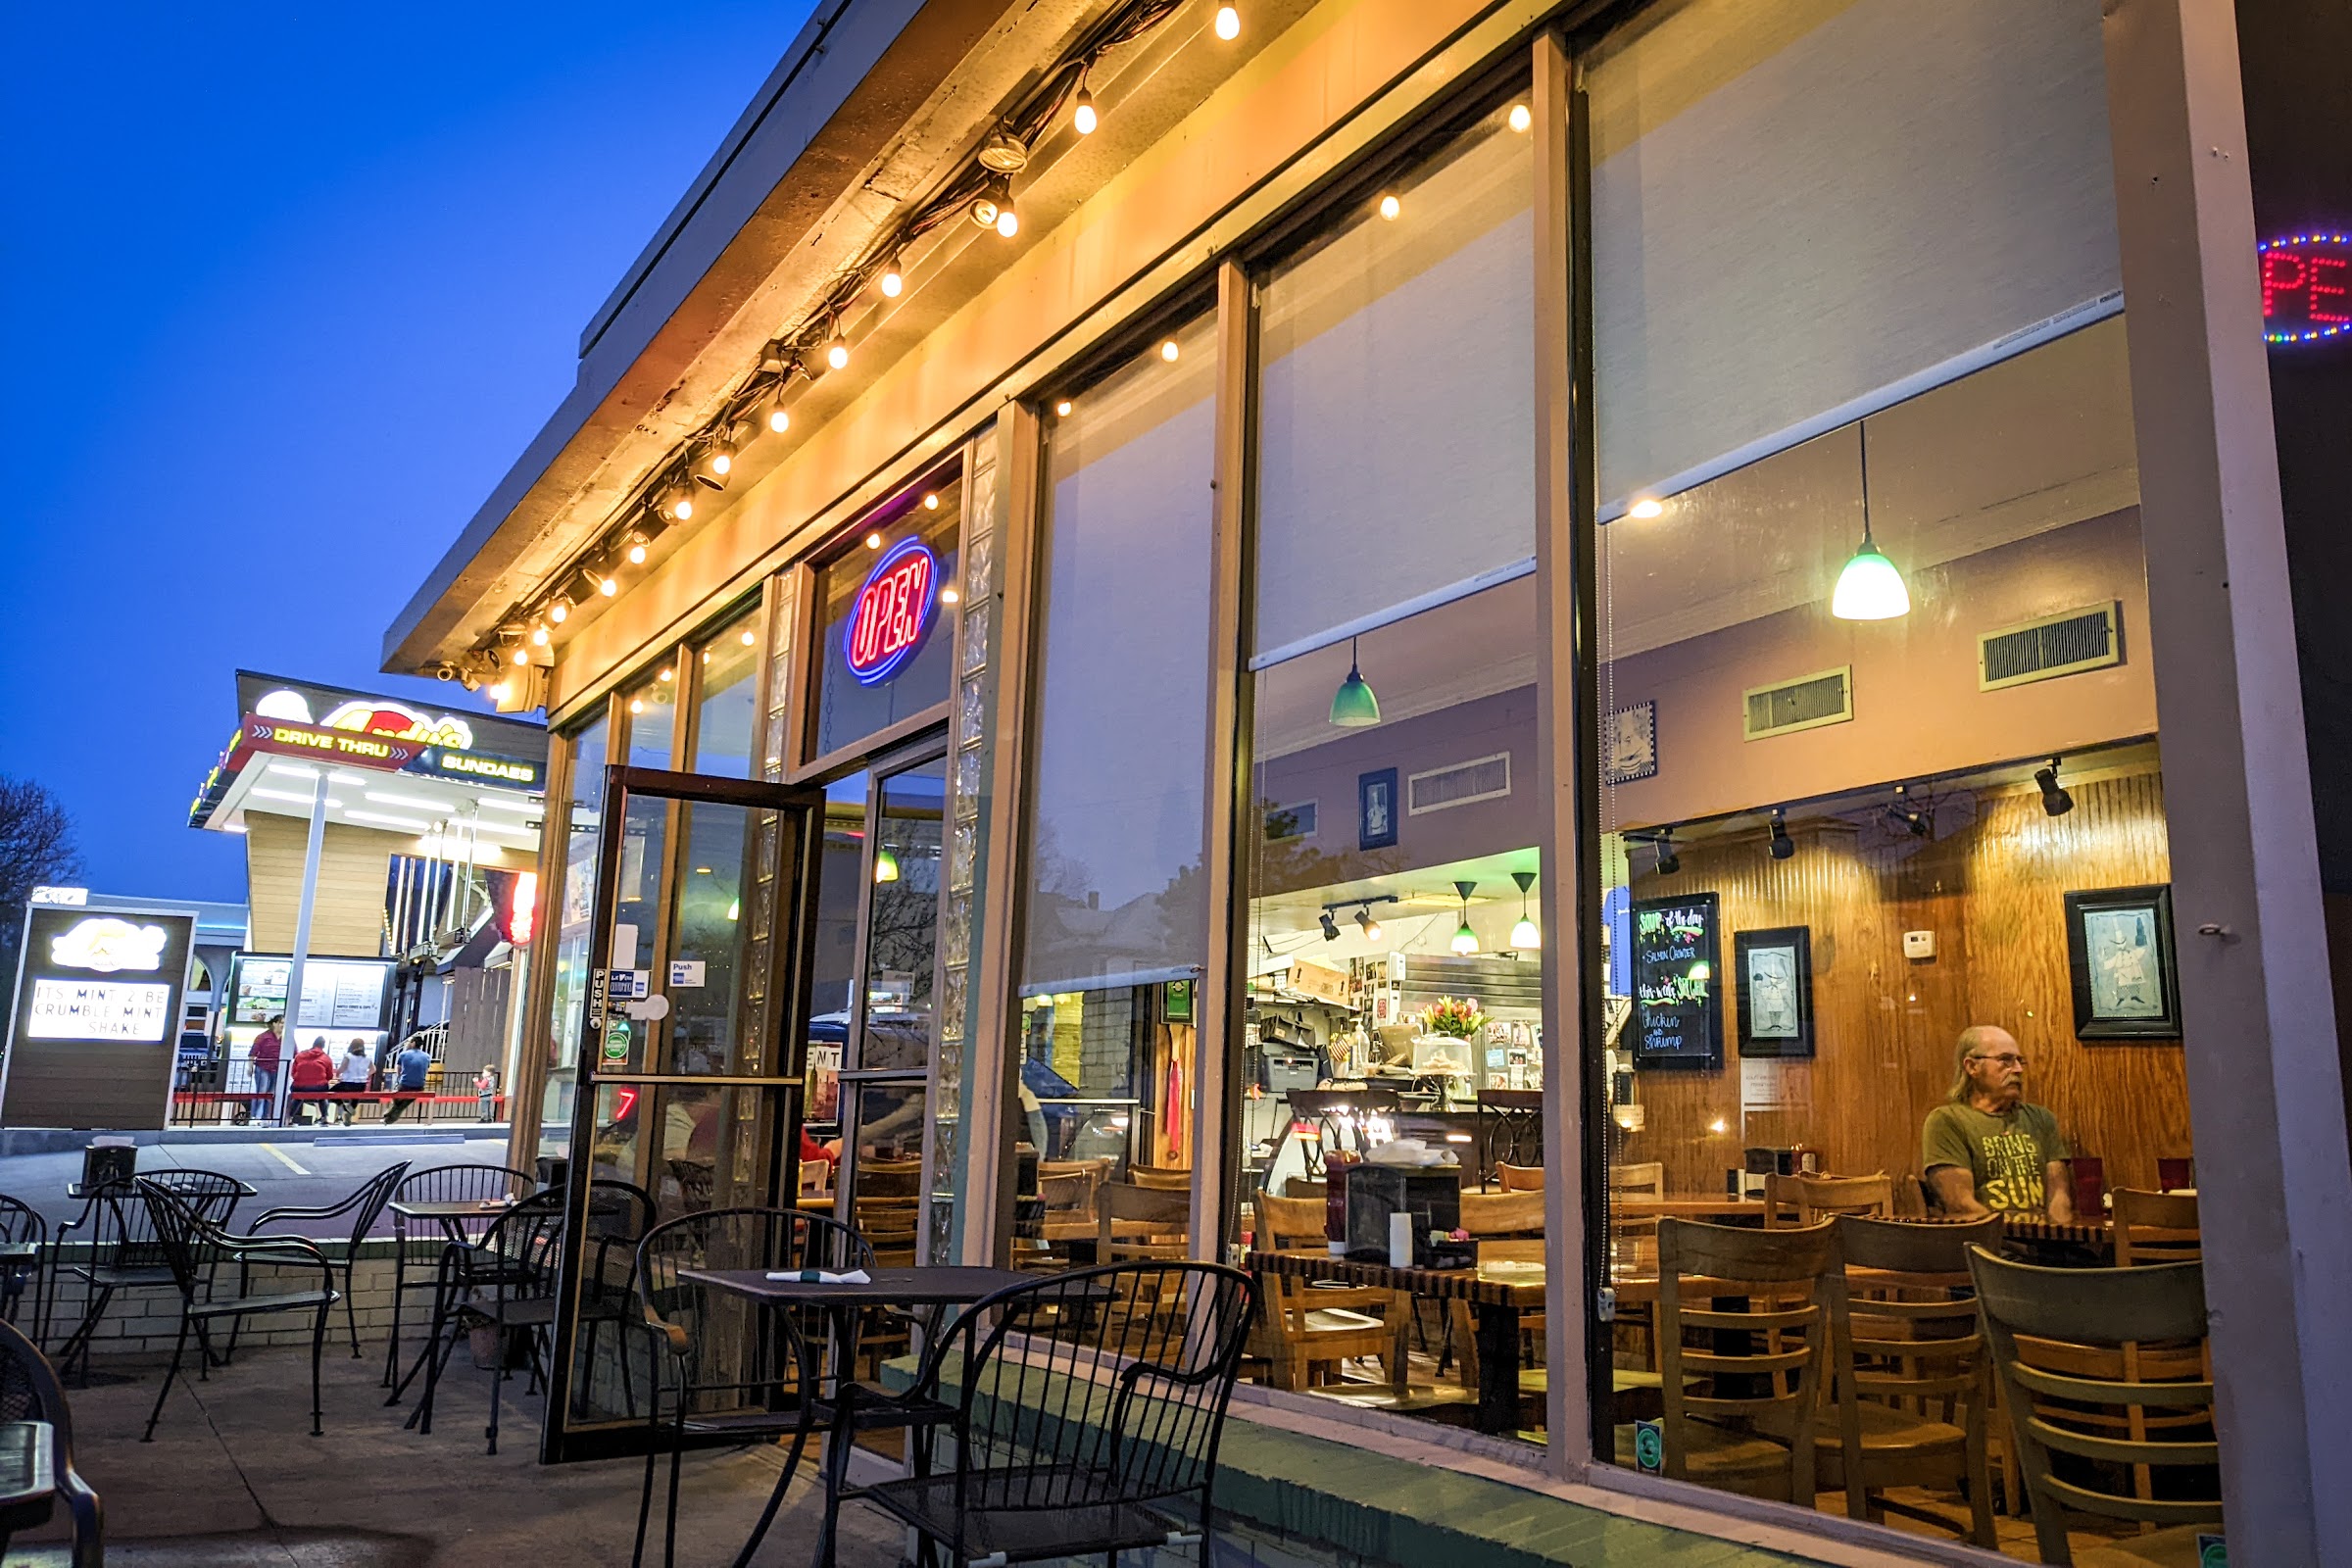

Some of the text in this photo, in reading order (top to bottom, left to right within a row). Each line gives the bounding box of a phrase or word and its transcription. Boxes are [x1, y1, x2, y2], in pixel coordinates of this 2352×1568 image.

[2263, 251, 2352, 321] PE
[852, 556, 929, 668] OPEN
[273, 727, 389, 758] DRIVE THRU
[442, 755, 534, 782] SUNDAES
[1639, 911, 1663, 935] SOUP
[1674, 909, 1686, 926] the
[1687, 908, 1704, 928] day
[36, 986, 165, 1004] ITS MINT 2 BE
[592, 970, 605, 1008] PUSH
[34, 1004, 162, 1018] CRUMBLE MINT
[88, 1021, 141, 1035] SHAKE
[1983, 1134, 2036, 1157] BRING
[1986, 1152, 2041, 1179] ON THE
[1986, 1176, 2044, 1209] SUN
